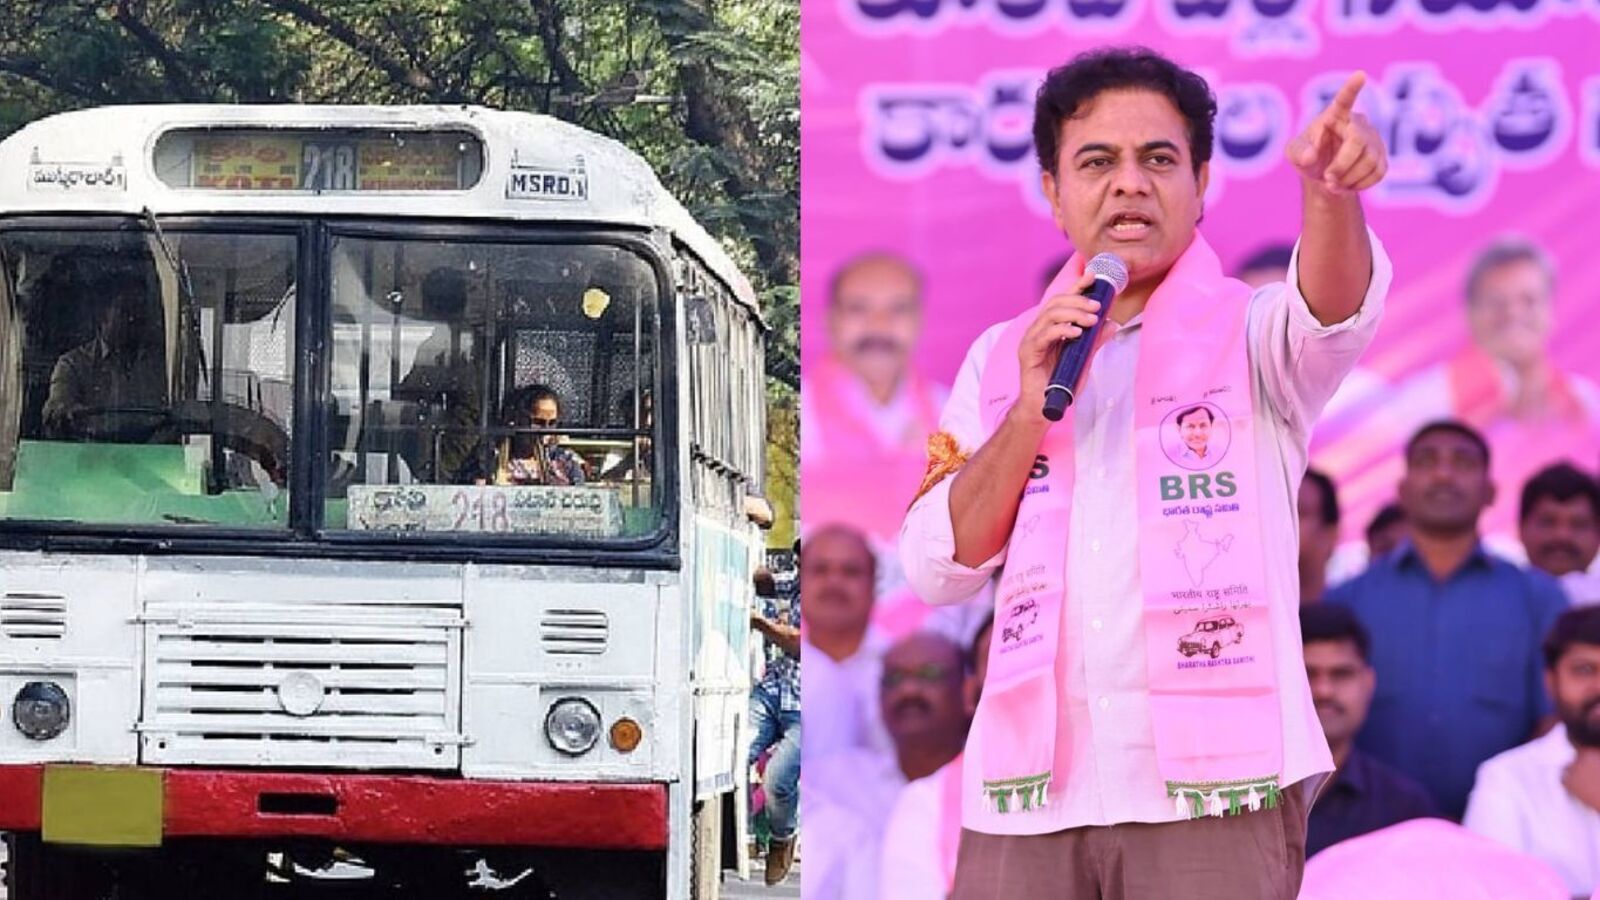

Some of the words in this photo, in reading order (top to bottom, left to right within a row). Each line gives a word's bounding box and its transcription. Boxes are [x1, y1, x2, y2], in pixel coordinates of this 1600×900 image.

[303, 143, 356, 189] 218
[511, 174, 584, 197] MSRD.1
[1160, 471, 1237, 501] BRS
[451, 491, 509, 531] 218
